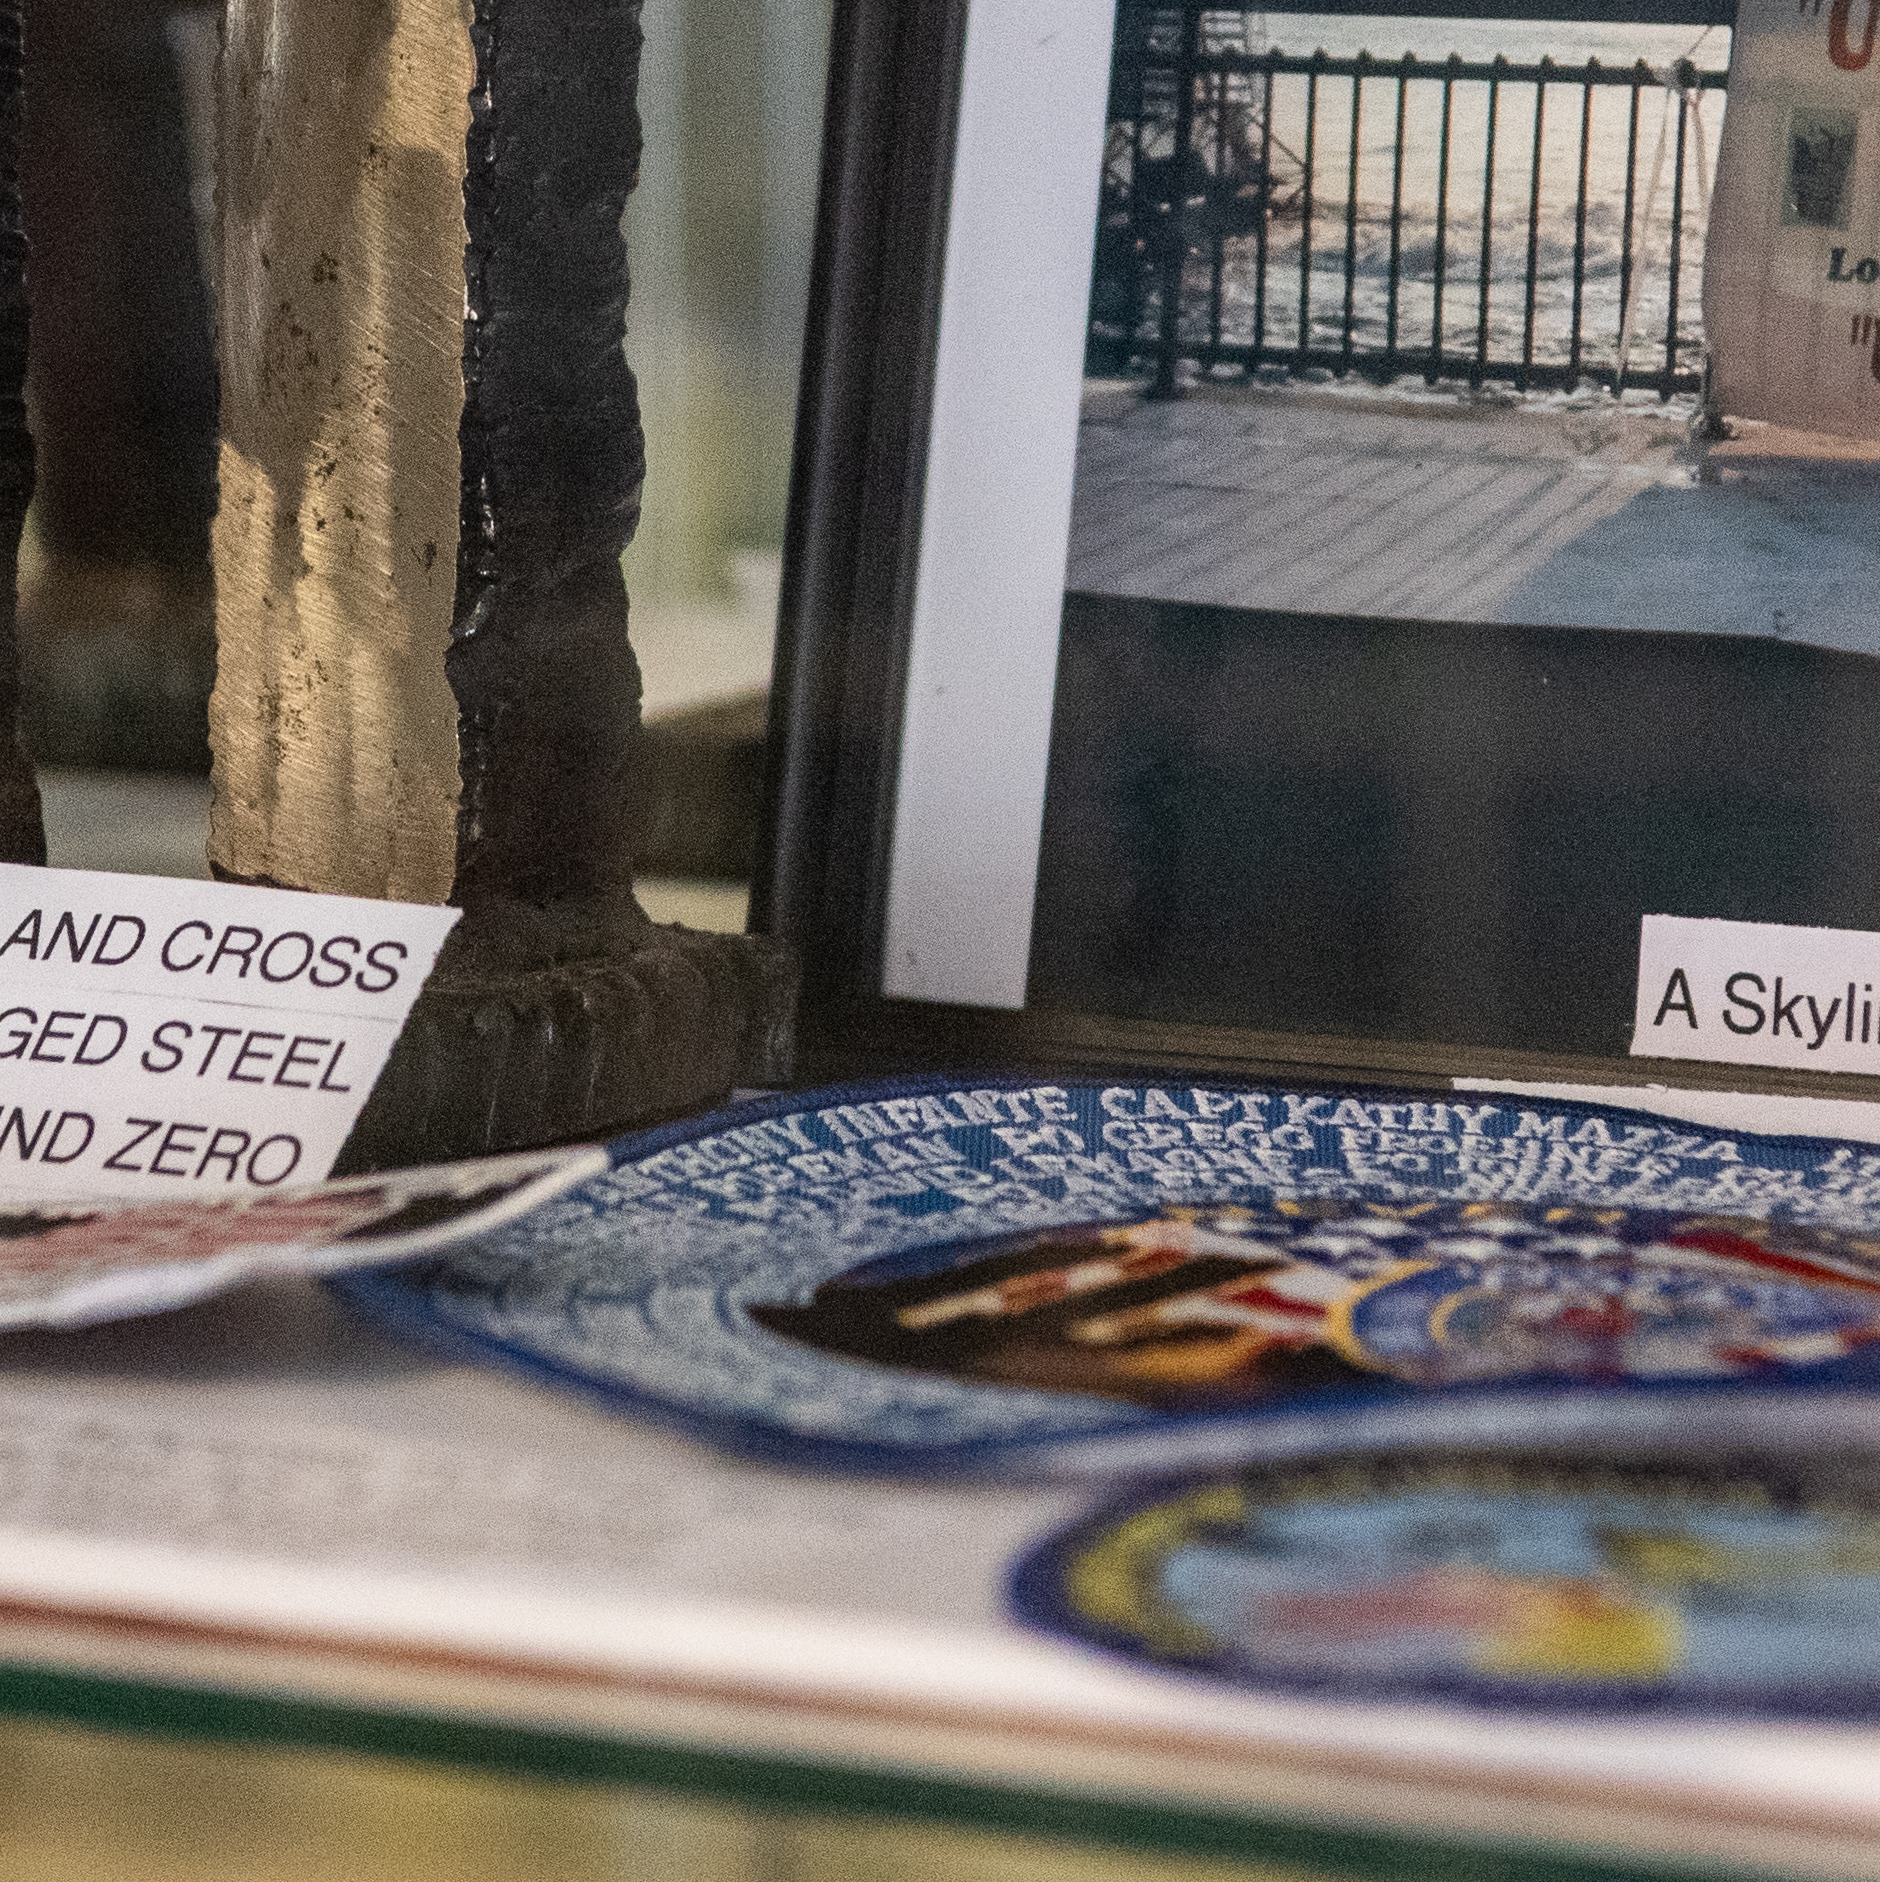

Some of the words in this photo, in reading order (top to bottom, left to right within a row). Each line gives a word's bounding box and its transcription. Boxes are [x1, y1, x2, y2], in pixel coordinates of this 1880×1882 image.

[161, 920, 408, 993] CROSS
[1653, 968, 1698, 1030] A
[141, 1020, 350, 1094] STEEL
[818, 1086, 1078, 1145] INFANTE
[1100, 1086, 1271, 1123] CAPT
[1279, 1093, 1502, 1136] KATHY
[103, 1117, 302, 1188] ZERO
